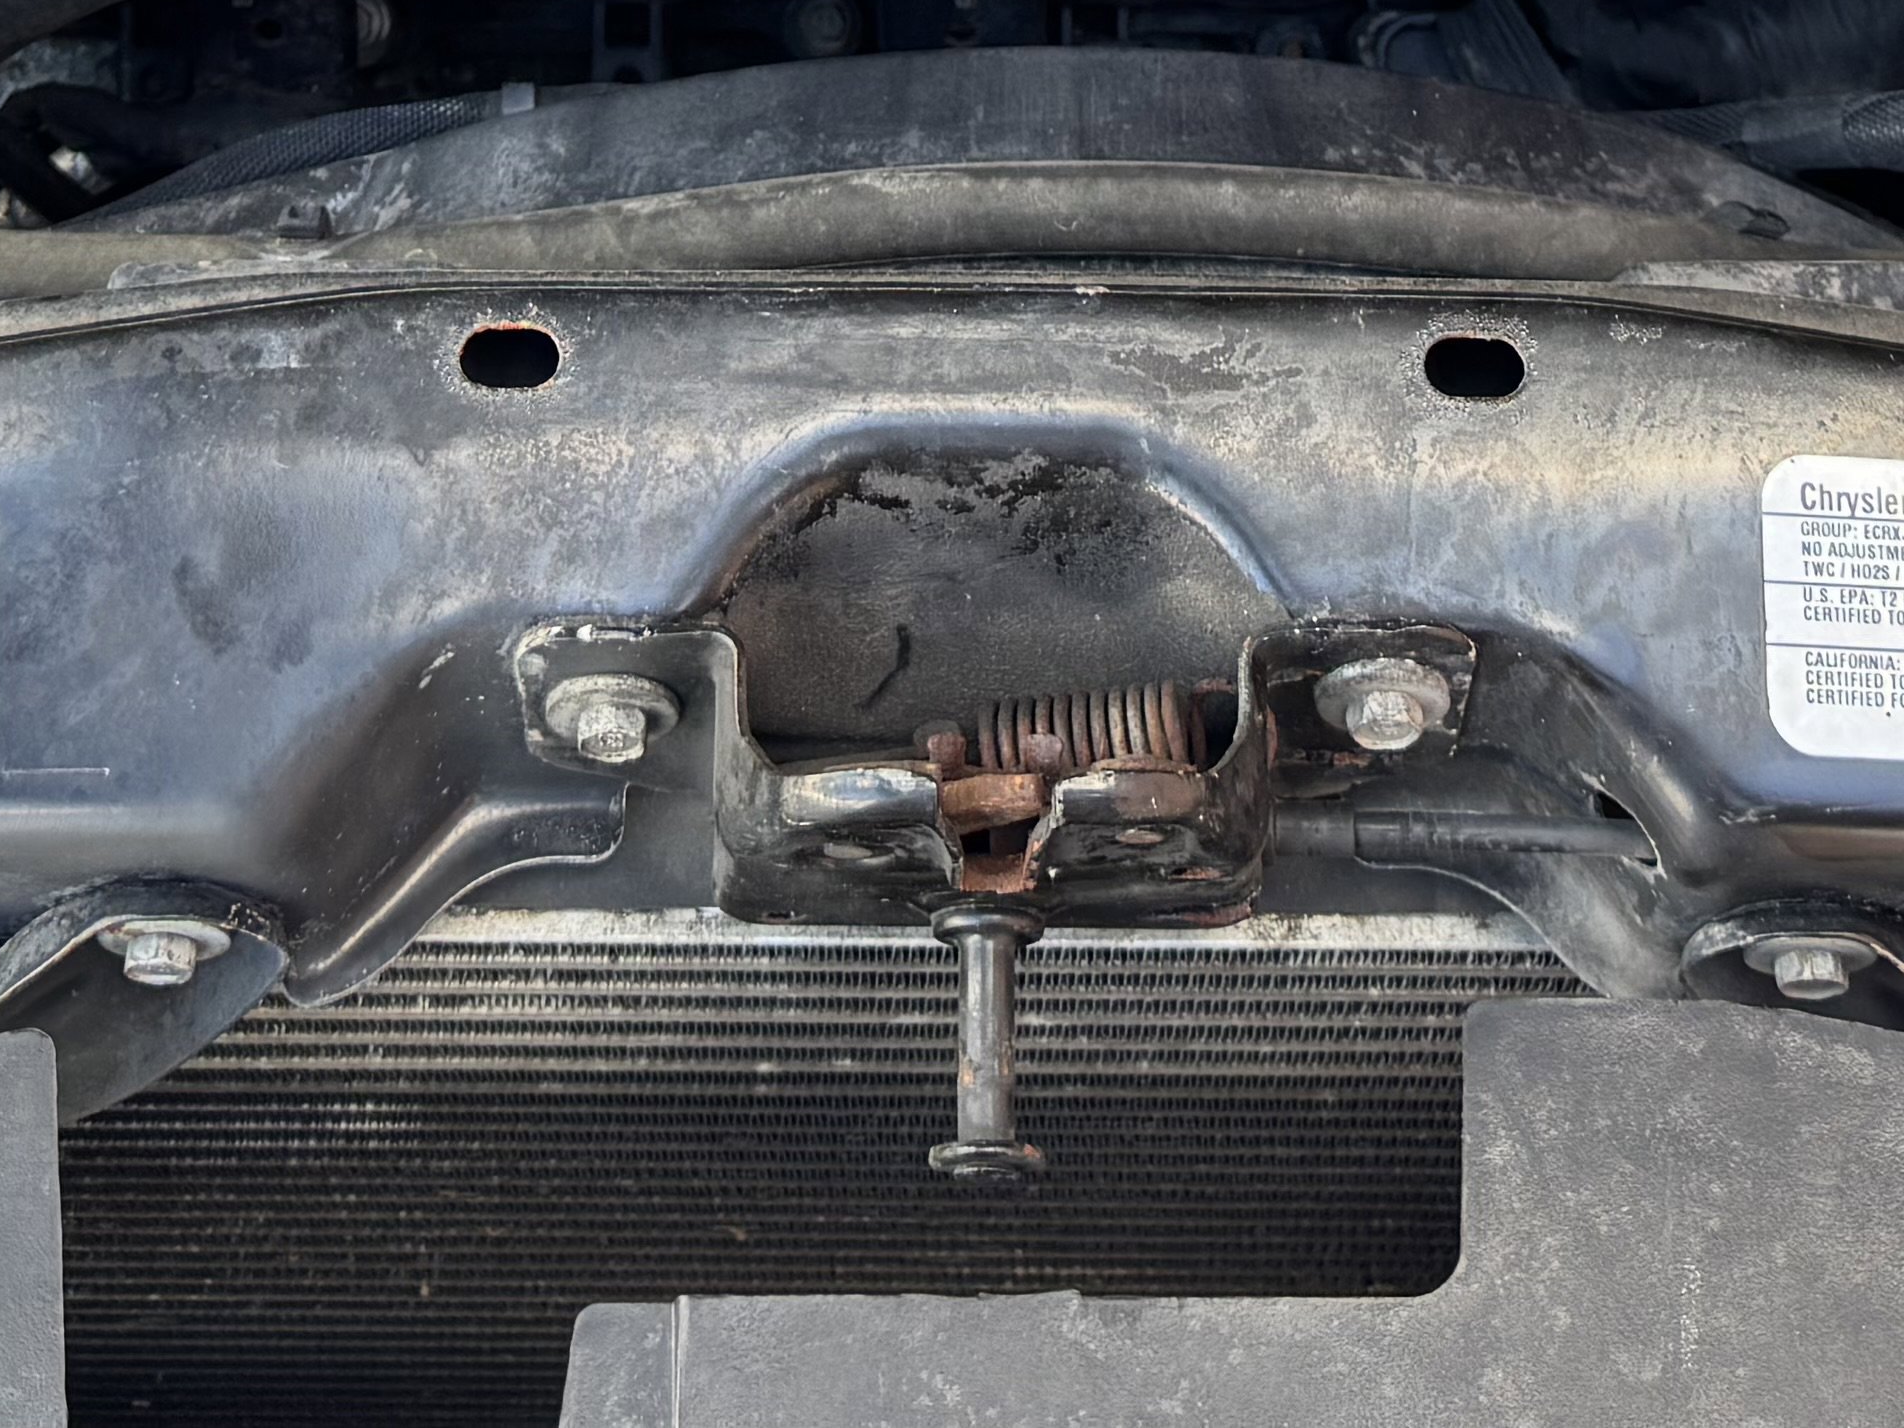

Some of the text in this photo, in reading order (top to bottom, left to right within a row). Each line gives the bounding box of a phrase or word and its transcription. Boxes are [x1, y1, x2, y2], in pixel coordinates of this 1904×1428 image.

[1801, 522, 1857, 540] GROUP:
[1801, 541, 1822, 557] NO
[1804, 561, 1835, 577] TWC
[1851, 564, 1890, 580] HO2S
[1804, 587, 1833, 603] U.S.
[1840, 589, 1874, 606] EPA:
[1880, 592, 1897, 607] T2
[1803, 606, 1881, 624] CERTIFIED
[1805, 651, 1900, 671] CALIFORNIA:
[1806, 670, 1883, 688] CERTIFIED
[1806, 688, 1884, 707] CERTIFIED
